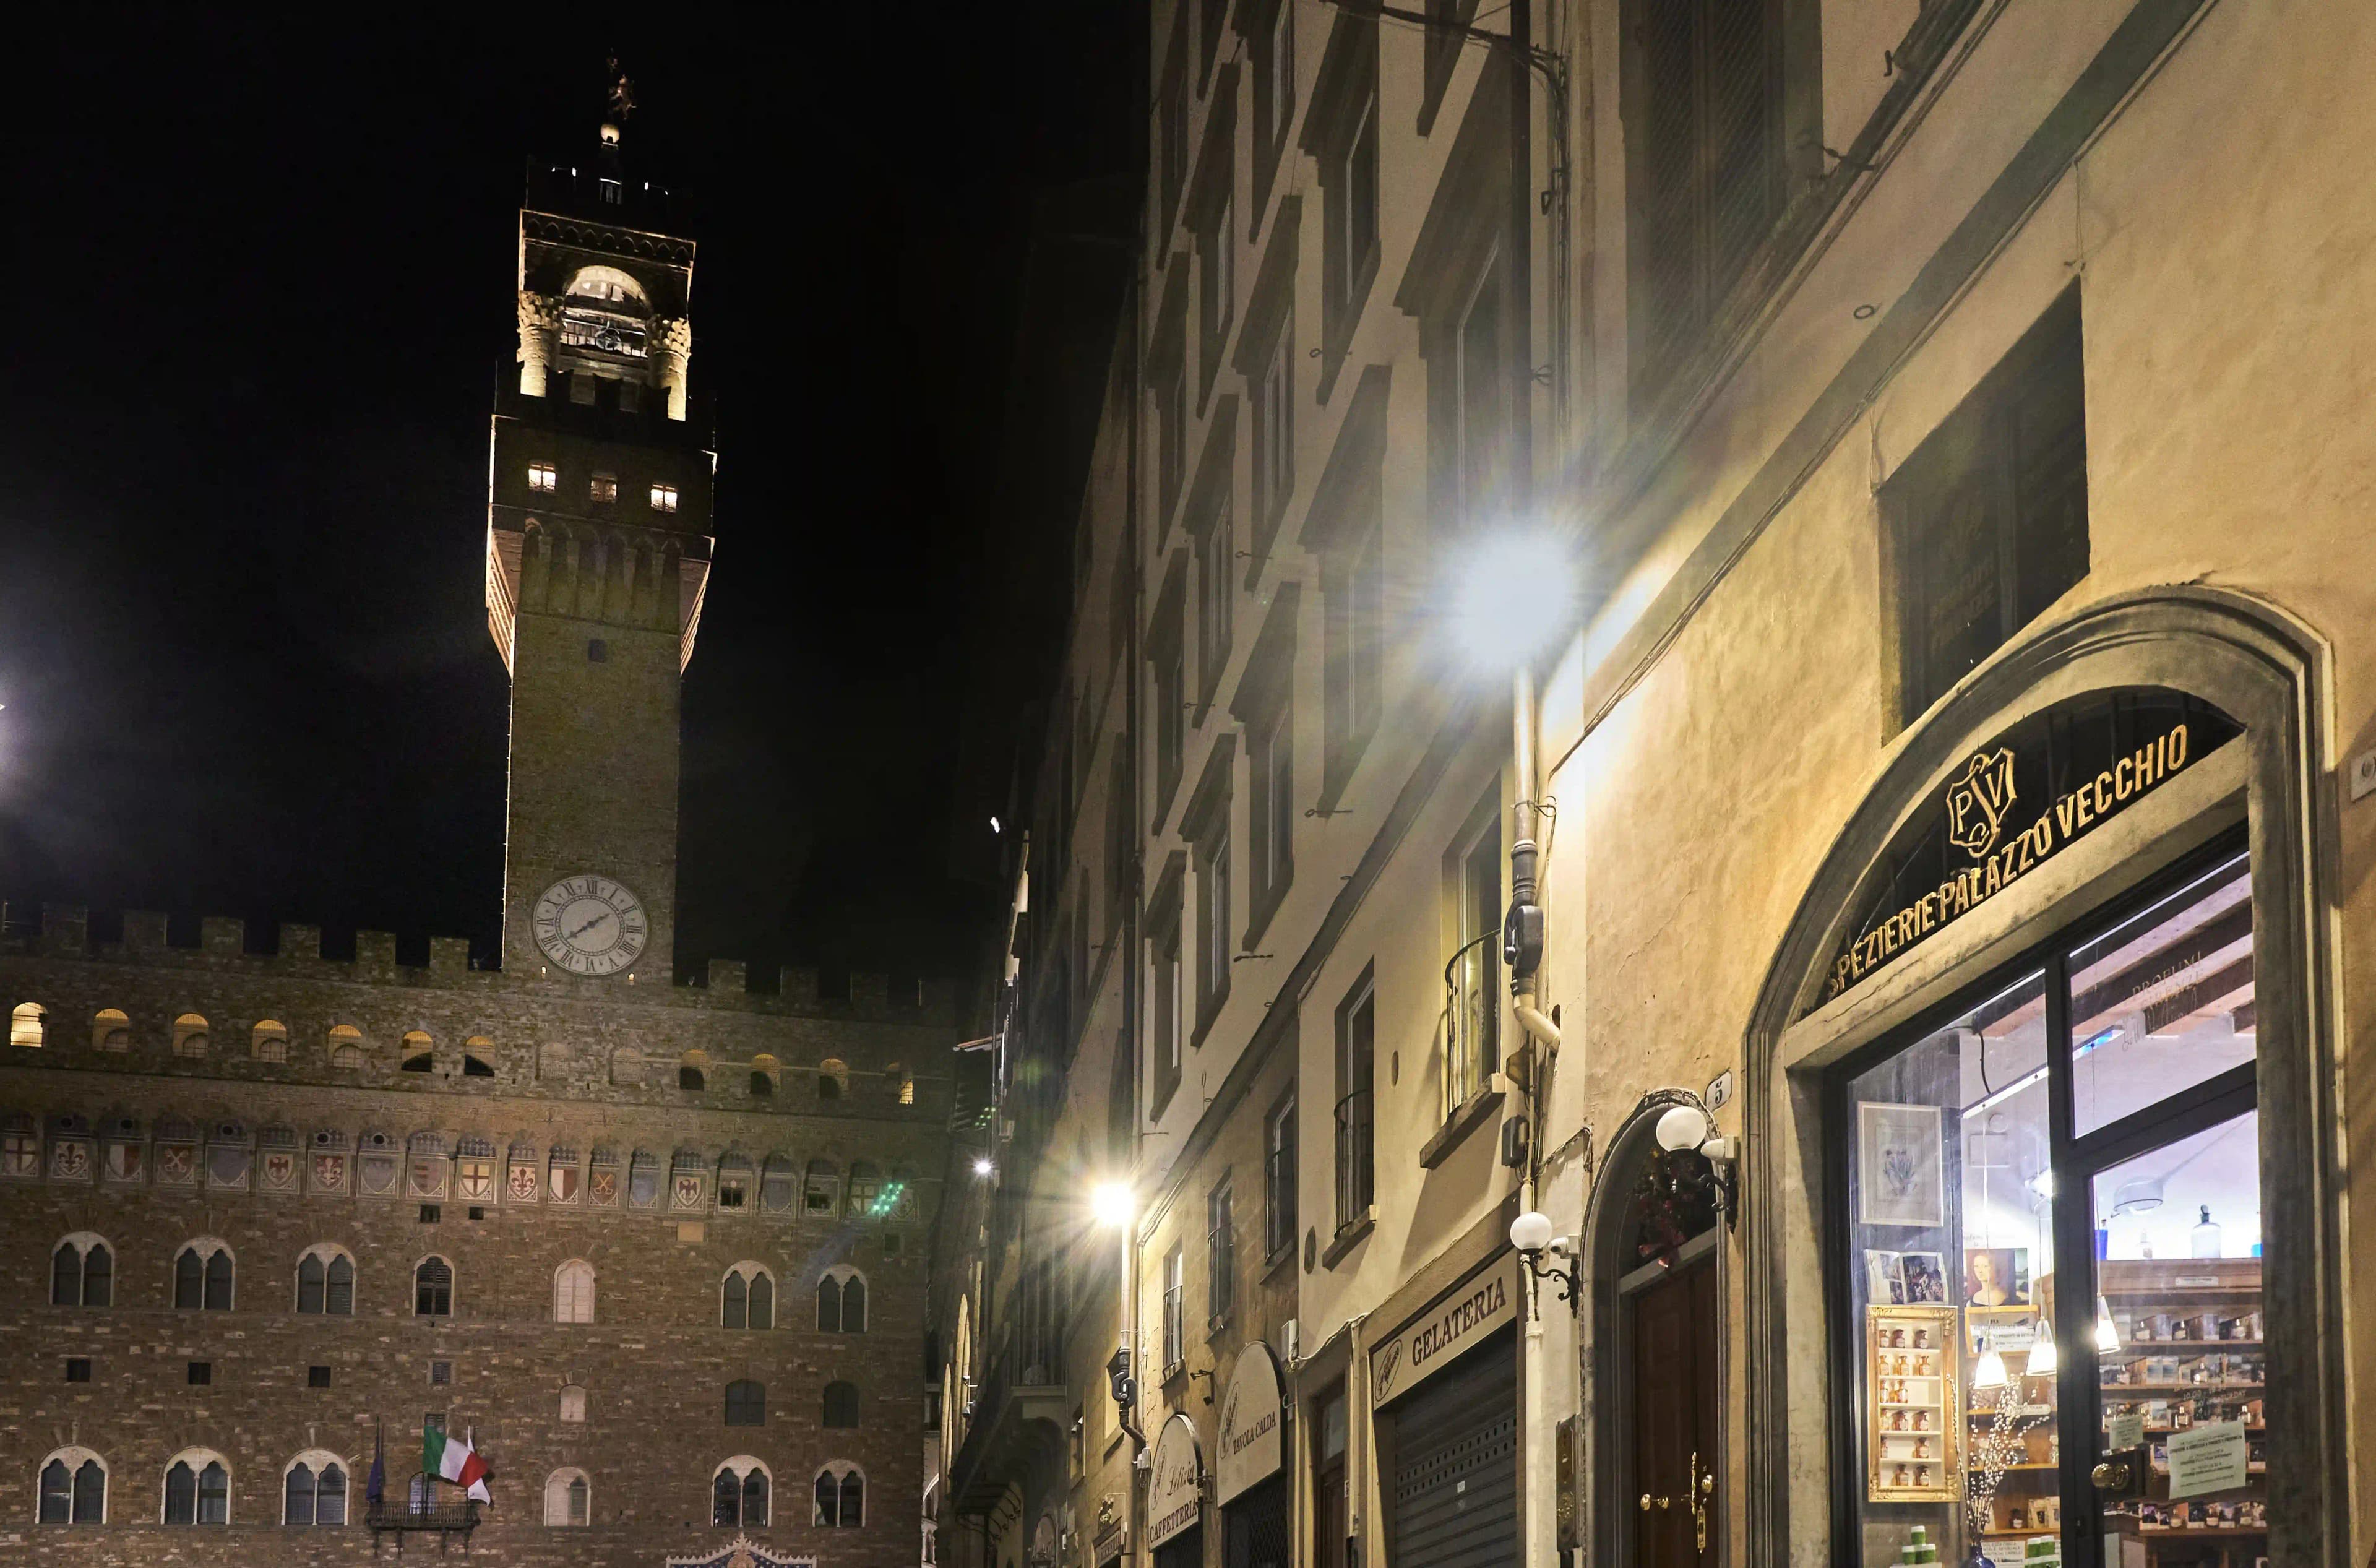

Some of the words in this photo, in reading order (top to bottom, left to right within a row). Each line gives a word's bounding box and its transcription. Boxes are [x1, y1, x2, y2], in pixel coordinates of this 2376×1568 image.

[1828, 891, 1935, 1001] SPEZIERIE
[1937, 816, 2052, 921] PALAZZO
[2055, 724, 2187, 838] VECCHIO
[584, 879, 598, 895] XII
[1412, 1277, 1507, 1367] GELATERIA
[1233, 1426, 1254, 1455] TAVOLA
[1255, 1410, 1276, 1439] CALDA
[1150, 1497, 1198, 1543] CAFFETTERIA
